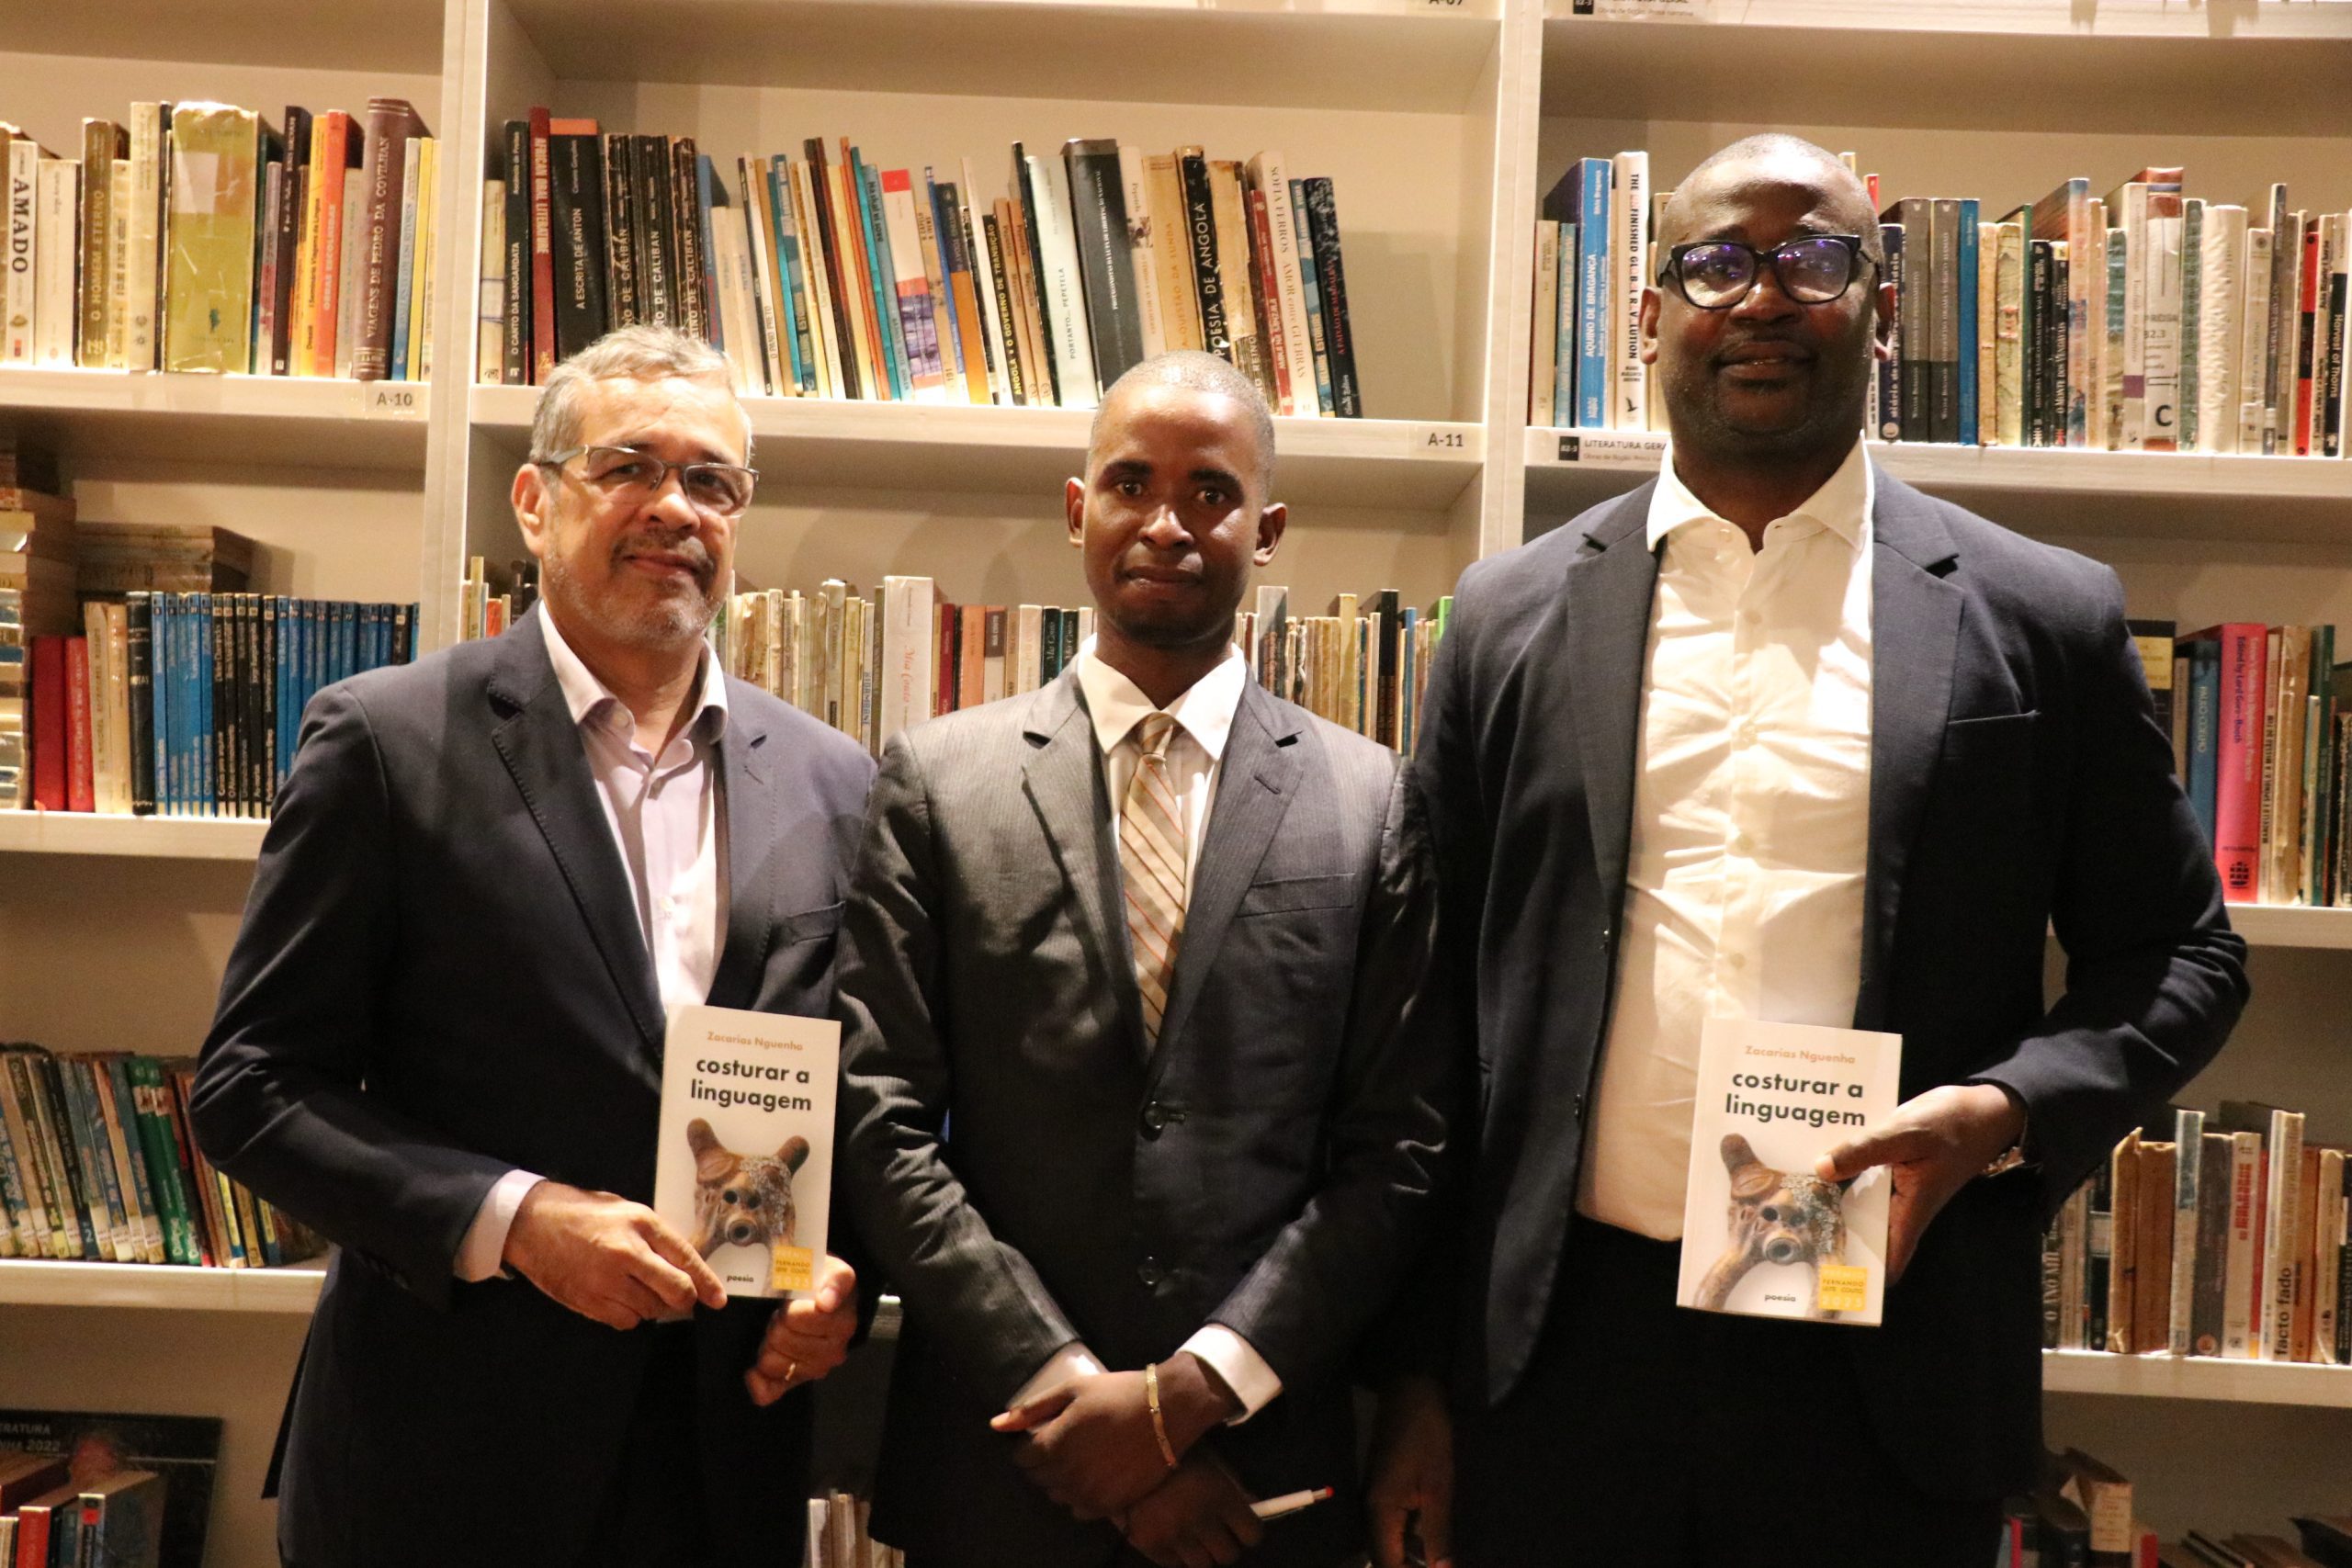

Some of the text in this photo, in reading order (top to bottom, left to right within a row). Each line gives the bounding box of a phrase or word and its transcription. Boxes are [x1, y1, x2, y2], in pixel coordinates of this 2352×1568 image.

[535, 138, 548, 254] AFRICAN ORAL LITERATURE
[1131, 183, 1140, 212] Pepetela
[1630, 174, 1639, 191] THE
[13, 178, 30, 273] AMADO
[90, 190, 103, 244] ETERNO
[573, 209, 582, 242] ANTON
[368, 136, 390, 338] VIAGENS DE PEDRO DA COVILHAN
[574, 244, 583, 257] DE
[950, 240, 961, 262] TODAY
[986, 224, 1002, 275] TRANSIÇÃO
[1104, 242, 1113, 255] LUTA
[1165, 222, 1178, 258] LUNDA
[619, 228, 631, 280] CALIBAN
[651, 231, 662, 282] CALIBAN
[684, 230, 696, 281] CALIBAN
[91, 251, 102, 304] HOMEM
[512, 243, 520, 300] SANGARDATA
[575, 259, 585, 299] ESCRITA
[996, 277, 1005, 289] DE
[1058, 267, 1069, 307] PEPETELA
[1170, 265, 1180, 279] DA
[1194, 203, 1225, 356] POESIA DE ANGOLA
[1271, 166, 1306, 378] SOFIA FERROS AMOR entre GUERRAS
[1328, 259, 1340, 304] MADALENA
[512, 302, 519, 314] DA
[623, 287, 632, 302] DE
[655, 289, 663, 304] DE
[688, 289, 697, 303] DE
[1170, 286, 1186, 333] QUESTÃO
[1586, 254, 1598, 357] AQUINO DE BRAGANÇA
[90, 310, 101, 321] O
[764, 306, 775, 330] PRETO
[998, 292, 1013, 336] GOVERNO
[1332, 306, 1340, 318] DE
[768, 333, 777, 353] PANO
[1333, 320, 1344, 347] PAIXÃO
[1249, 336, 1261, 371] REINO
[2330, 314, 2343, 398] Harvest of Thorns
[1010, 358, 1023, 395] ANGOLA
[1341, 375, 1351, 394] Editora
[377, 392, 413, 407] A-10
[2154, 404, 2173, 427] C
[1428, 433, 1464, 447] A-11
[1585, 440, 1642, 450] LITERATURA
[1046, 622, 1056, 660] Mia Couto
[1065, 620, 1074, 659] Mia Couto
[901, 646, 916, 703] Mia Couto
[2233, 636, 2246, 743] Edited by Lord Gore-Booth
[2247, 669, 2256, 693] Guide
[2247, 694, 2256, 703] to
[2197, 685, 2209, 753] PAULO COELHO
[2262, 809, 2270, 843] MARCELLO
[707, 1032, 803, 1052] Zacarias Nguenha
[1745, 1045, 1856, 1065] Zacarias Nguenha
[696, 1058, 809, 1084] costurar a
[1733, 1073, 1863, 1098] costurar a
[691, 1079, 811, 1112] linguagem
[1725, 1094, 1866, 1127] linguagem
[726, 1274, 754, 1283] poesia
[775, 1259, 810, 1268] FERNANDO
[1764, 1292, 1796, 1303] poesia
[1822, 1279, 1864, 1287] FERNANDO
[2277, 1268, 2292, 1305] fado
[2043, 1280, 2059, 1320] O ANO
[2275, 1312, 2290, 1355] facto
